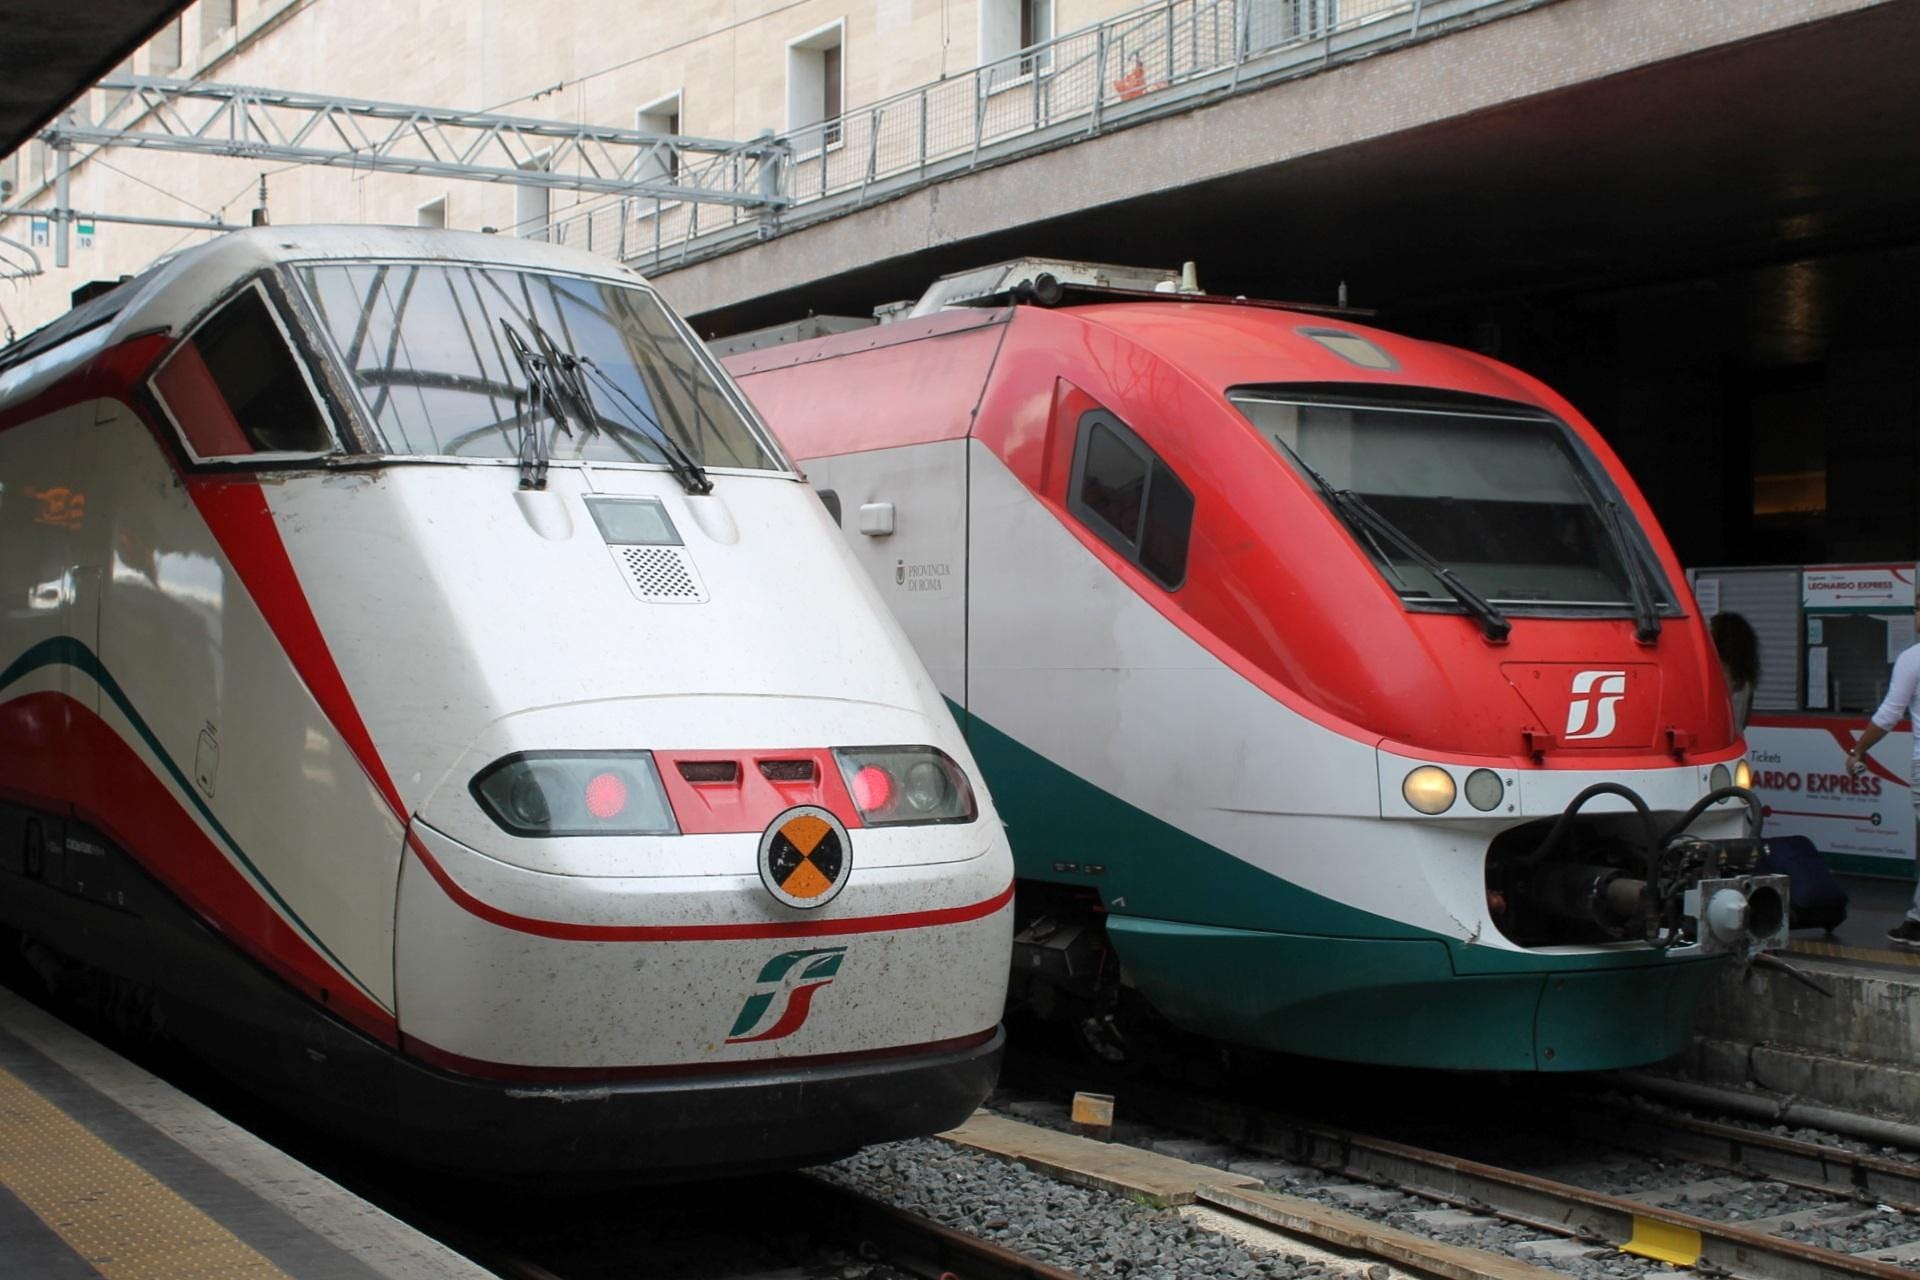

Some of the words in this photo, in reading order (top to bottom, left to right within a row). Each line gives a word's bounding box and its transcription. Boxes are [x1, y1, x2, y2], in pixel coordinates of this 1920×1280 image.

[81, 238, 91, 248] 10
[908, 564, 951, 577] PROVINCIA
[919, 579, 942, 591] ROMA
[1808, 582, 1855, 590] LEONARDO
[1857, 581, 1893, 590] EXPRESS
[1751, 751, 1781, 763] Tickets
[1806, 773, 1882, 796] EXPRESS
